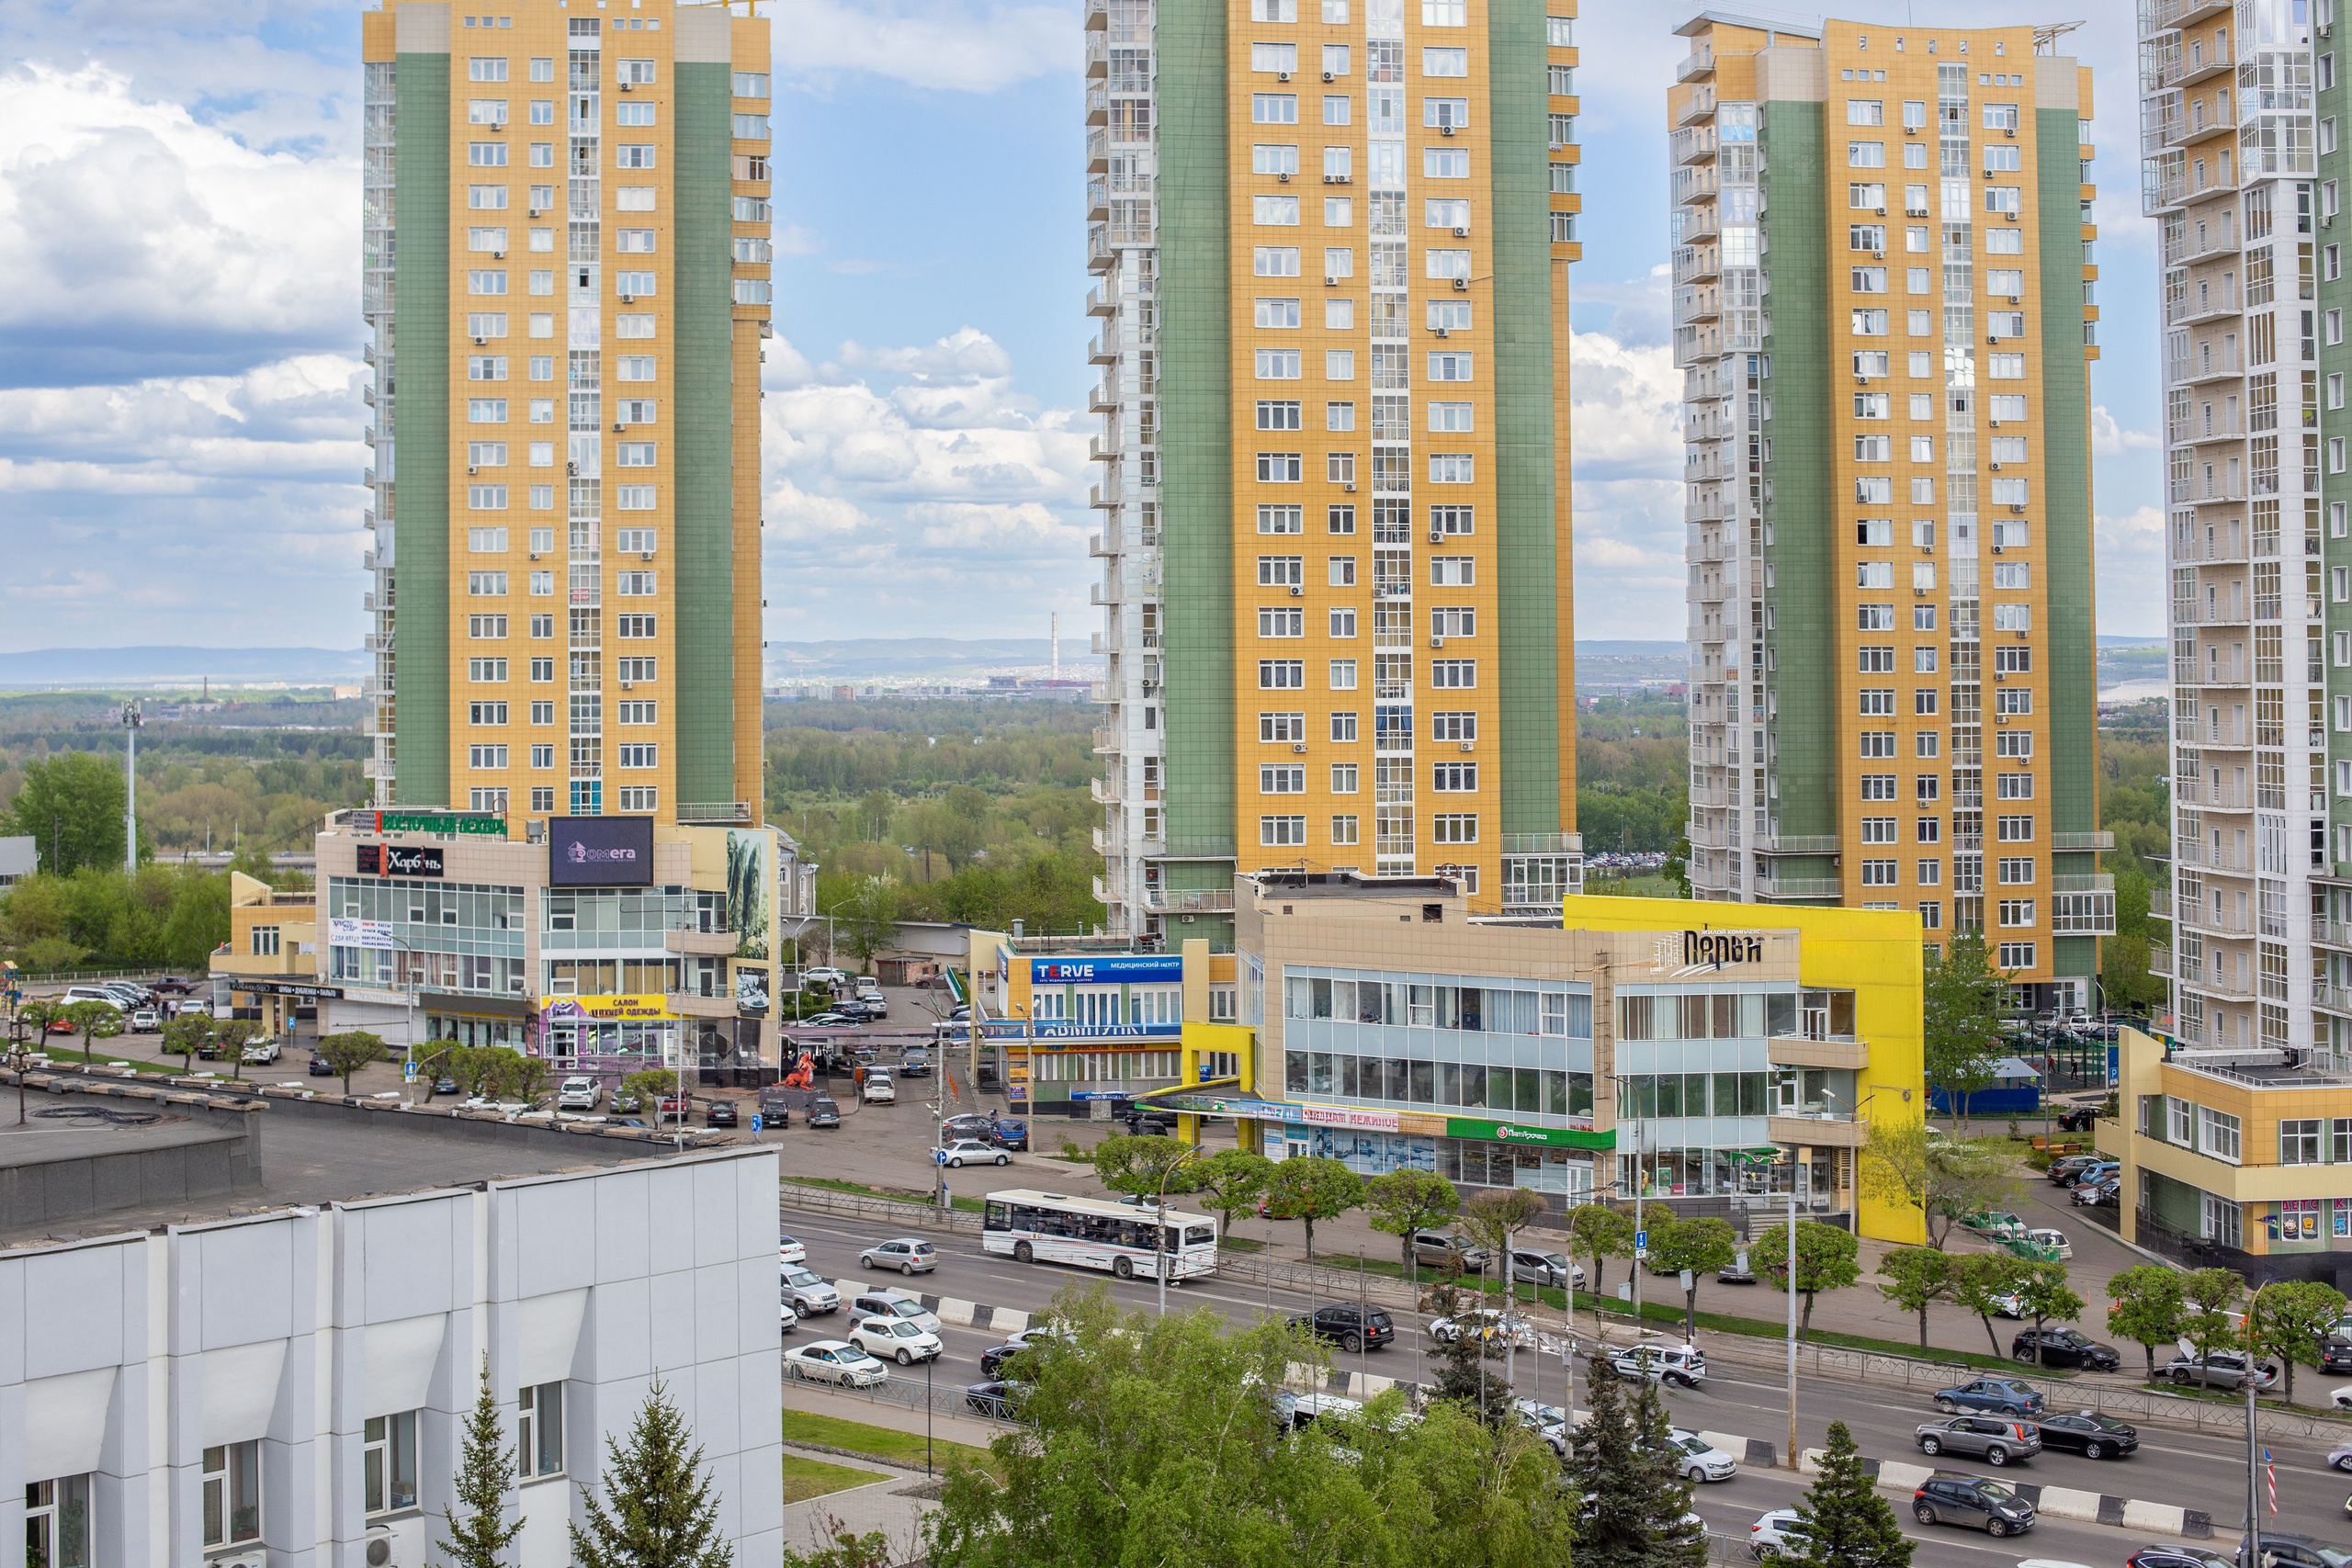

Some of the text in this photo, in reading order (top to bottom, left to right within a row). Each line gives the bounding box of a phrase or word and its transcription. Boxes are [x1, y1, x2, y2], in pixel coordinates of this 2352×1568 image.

[1110, 961, 1159, 969] МЕДИЦИНСКИЙ
[1037, 964, 1094, 977] TERVE
[626, 1008, 661, 1017] ОДЕЖДЫ
